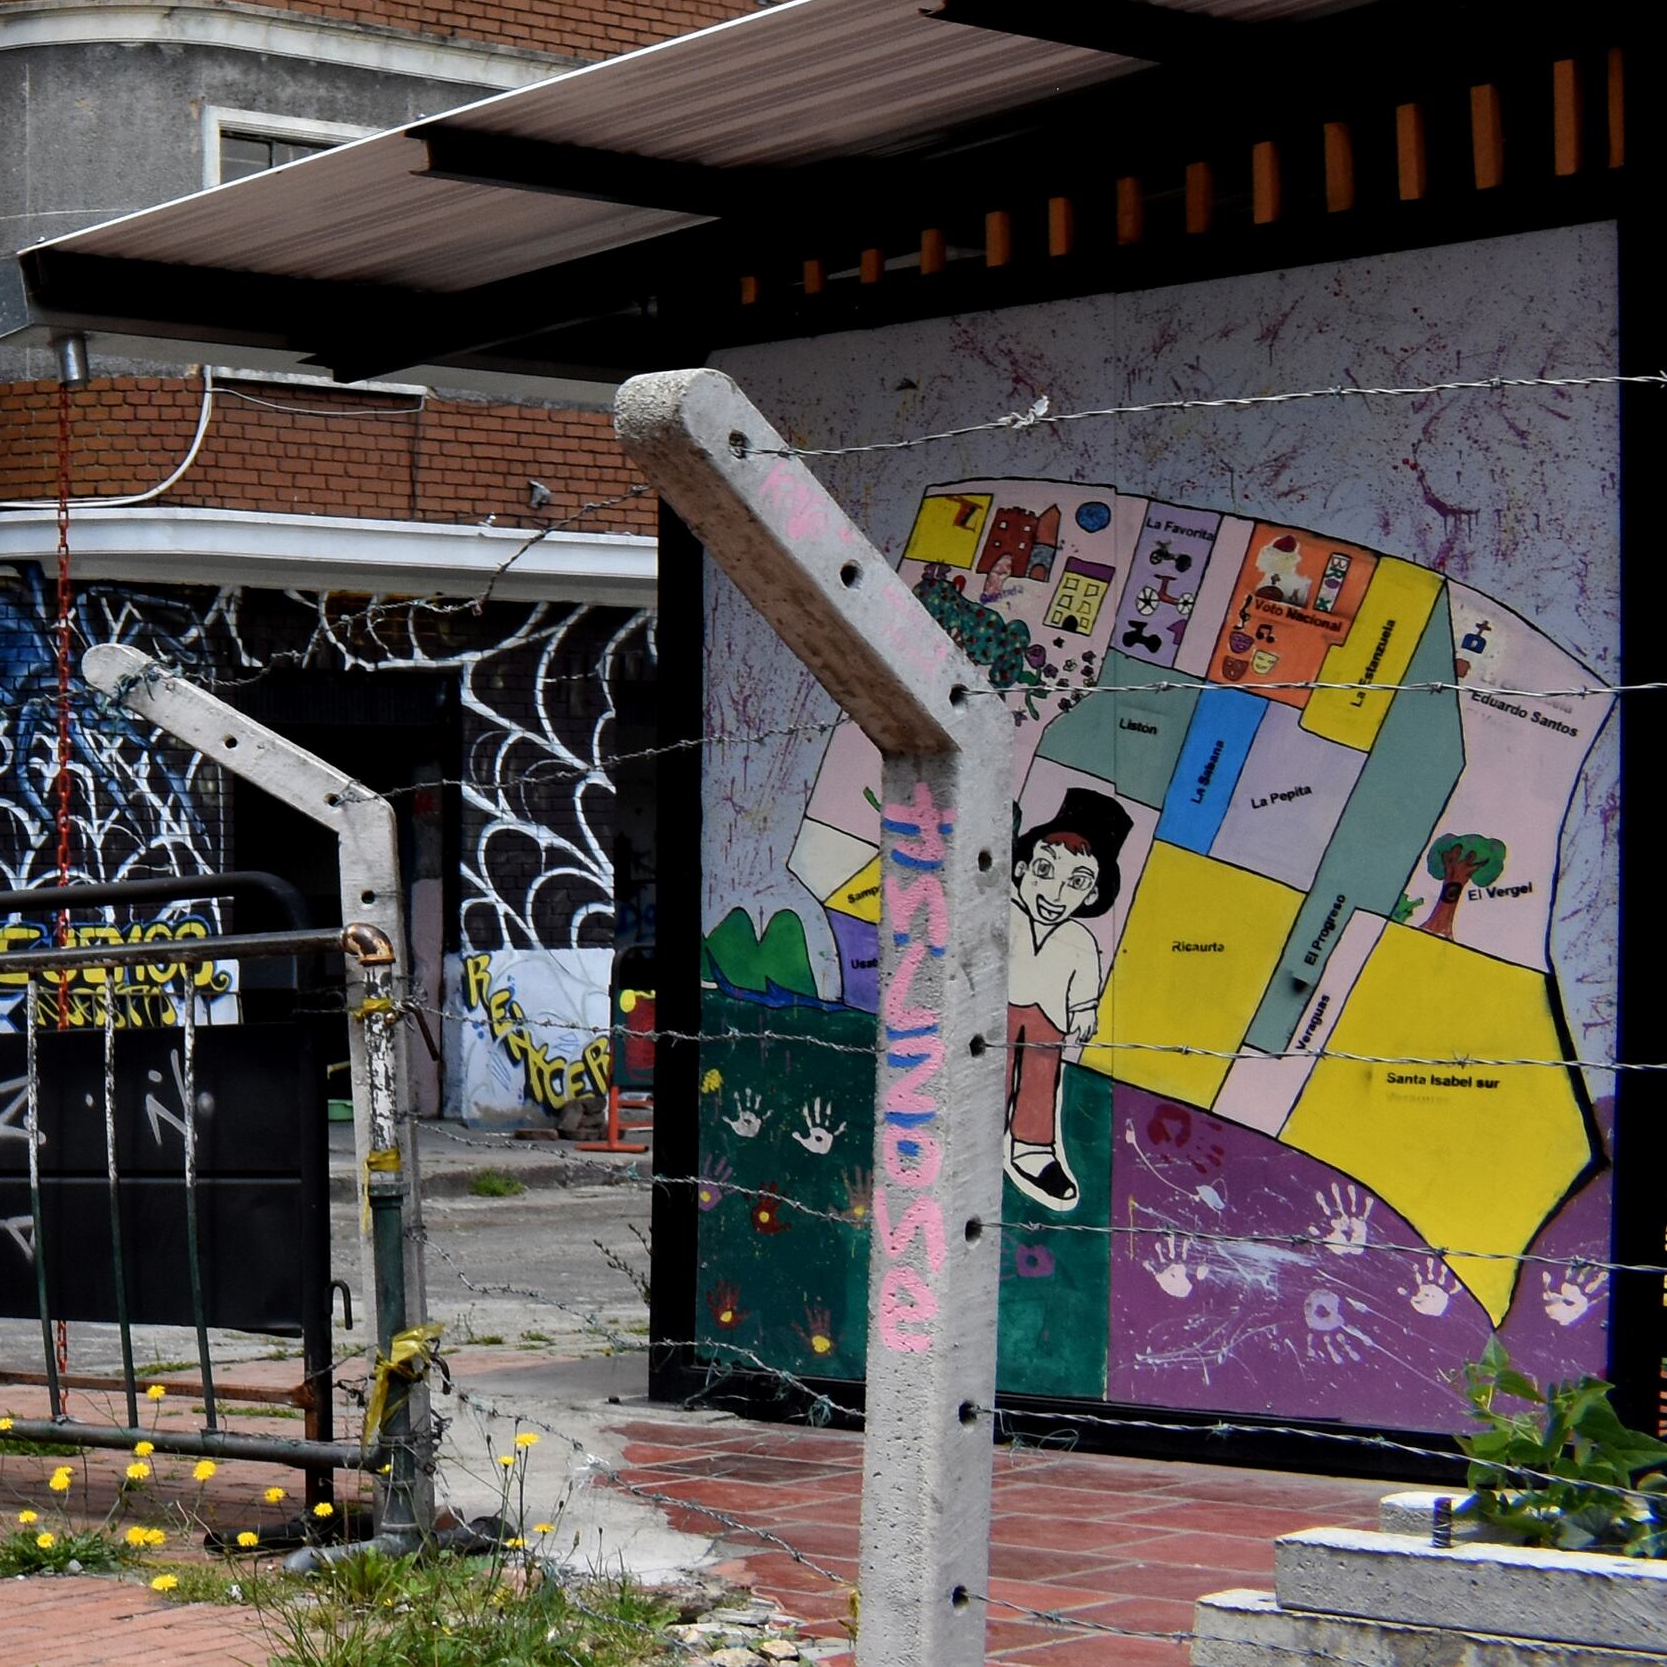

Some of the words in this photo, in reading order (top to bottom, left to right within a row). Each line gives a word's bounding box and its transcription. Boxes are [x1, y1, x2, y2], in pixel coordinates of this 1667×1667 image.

[1146, 517, 1164, 532] La
[1166, 519, 1215, 542] Favorita
[1255, 596, 1284, 617] Voto
[1286, 606, 1342, 633] Nacional
[1351, 689, 1371, 708] La
[1472, 690, 1528, 720] Eduardo
[1530, 710, 1580, 738] Santos
[1251, 796, 1269, 810] La
[1270, 784, 1313, 807] Pepita
[1467, 888, 1483, 901] El
[1303, 953, 1318, 967] El
[1313, 893, 1347, 954] Progreso
[1295, 993, 1331, 1052] Veraguas
[1386, 1071, 1427, 1086] Santa
[1429, 1073, 1473, 1088] Isabel
[1475, 1077, 1501, 1090] sur
